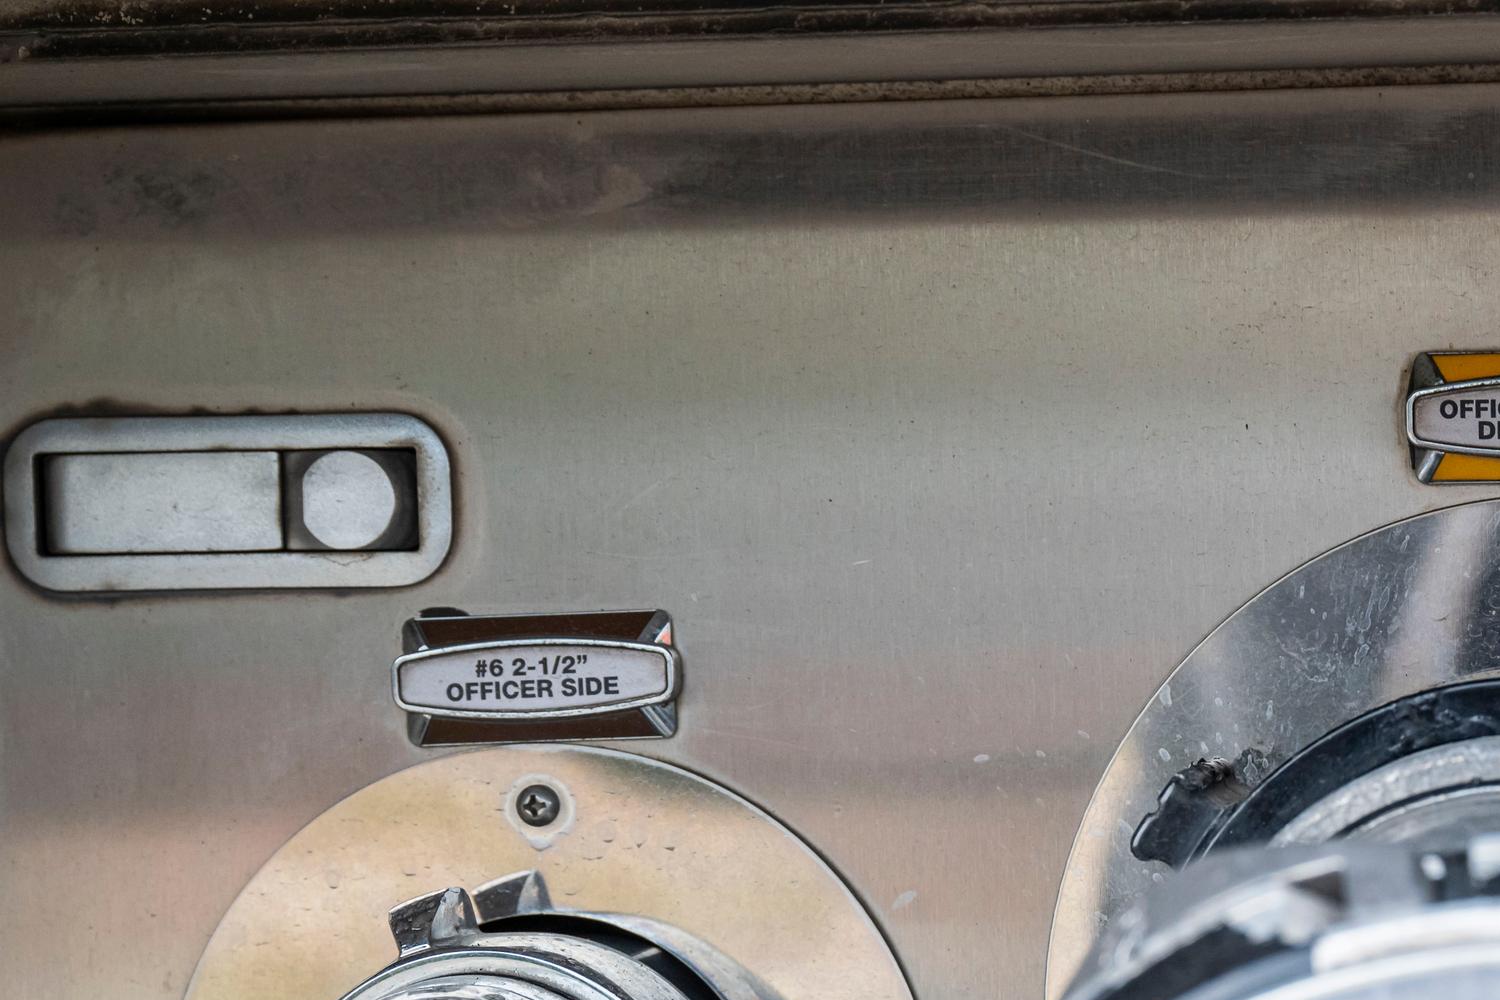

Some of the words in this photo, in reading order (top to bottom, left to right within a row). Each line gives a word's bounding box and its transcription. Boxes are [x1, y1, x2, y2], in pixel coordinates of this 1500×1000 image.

[475, 658, 504, 678] #6
[446, 679, 554, 702] OFFICER
[561, 676, 620, 697] SIDE
